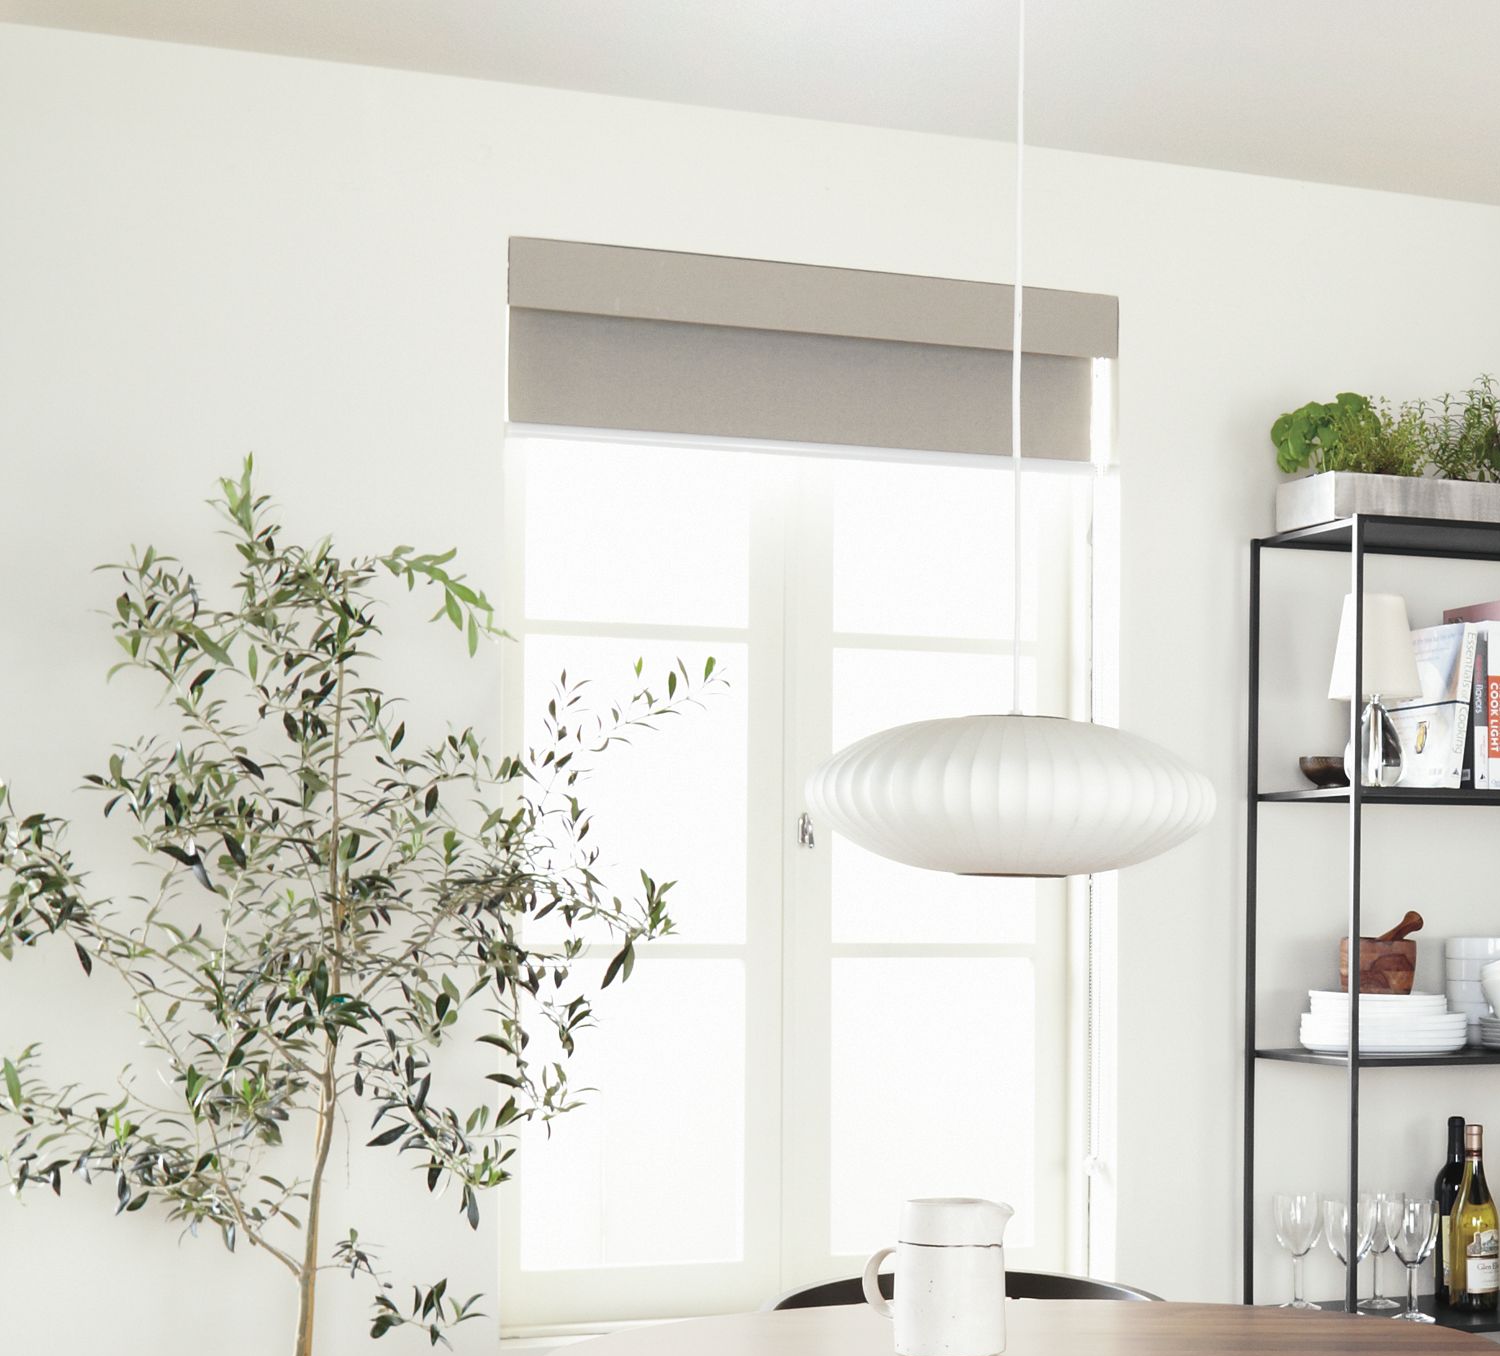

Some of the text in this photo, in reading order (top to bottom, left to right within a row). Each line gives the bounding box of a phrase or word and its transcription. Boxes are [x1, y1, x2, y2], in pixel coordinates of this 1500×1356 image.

[1462, 631, 1477, 690] Essentials
[1490, 682, 1499, 752] COOK LIGHT
